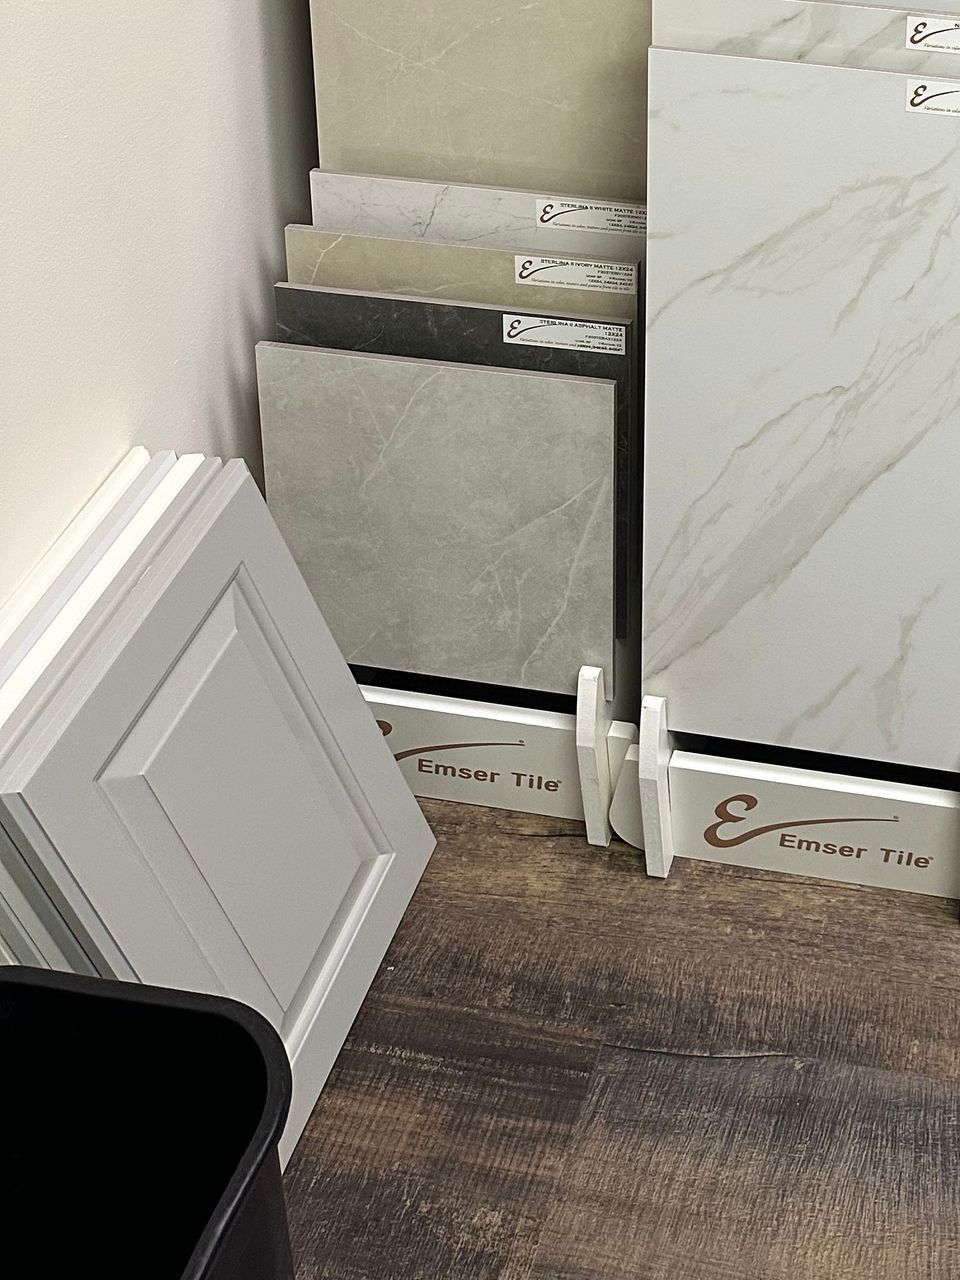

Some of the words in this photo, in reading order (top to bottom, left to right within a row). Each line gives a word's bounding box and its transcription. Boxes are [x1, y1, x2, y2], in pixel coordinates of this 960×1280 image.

[417, 758, 500, 783] Emser
[512, 772, 560, 792] Tile
[778, 832, 868, 859] Emser
[880, 847, 931, 869] Tile
